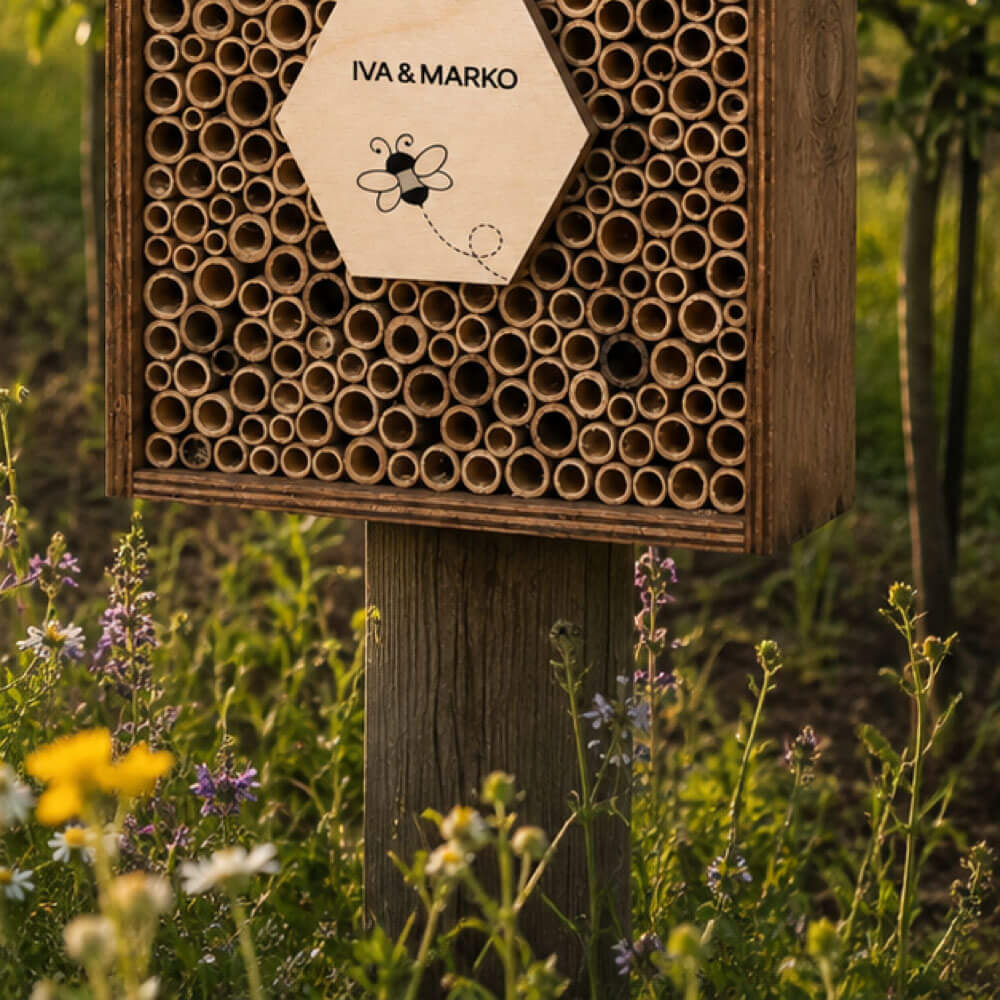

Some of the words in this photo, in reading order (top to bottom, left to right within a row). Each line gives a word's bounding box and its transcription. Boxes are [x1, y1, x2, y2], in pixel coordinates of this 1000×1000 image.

[353, 60, 393, 82] IVA
[397, 62, 416, 84] &
[420, 63, 518, 90] MARKO
